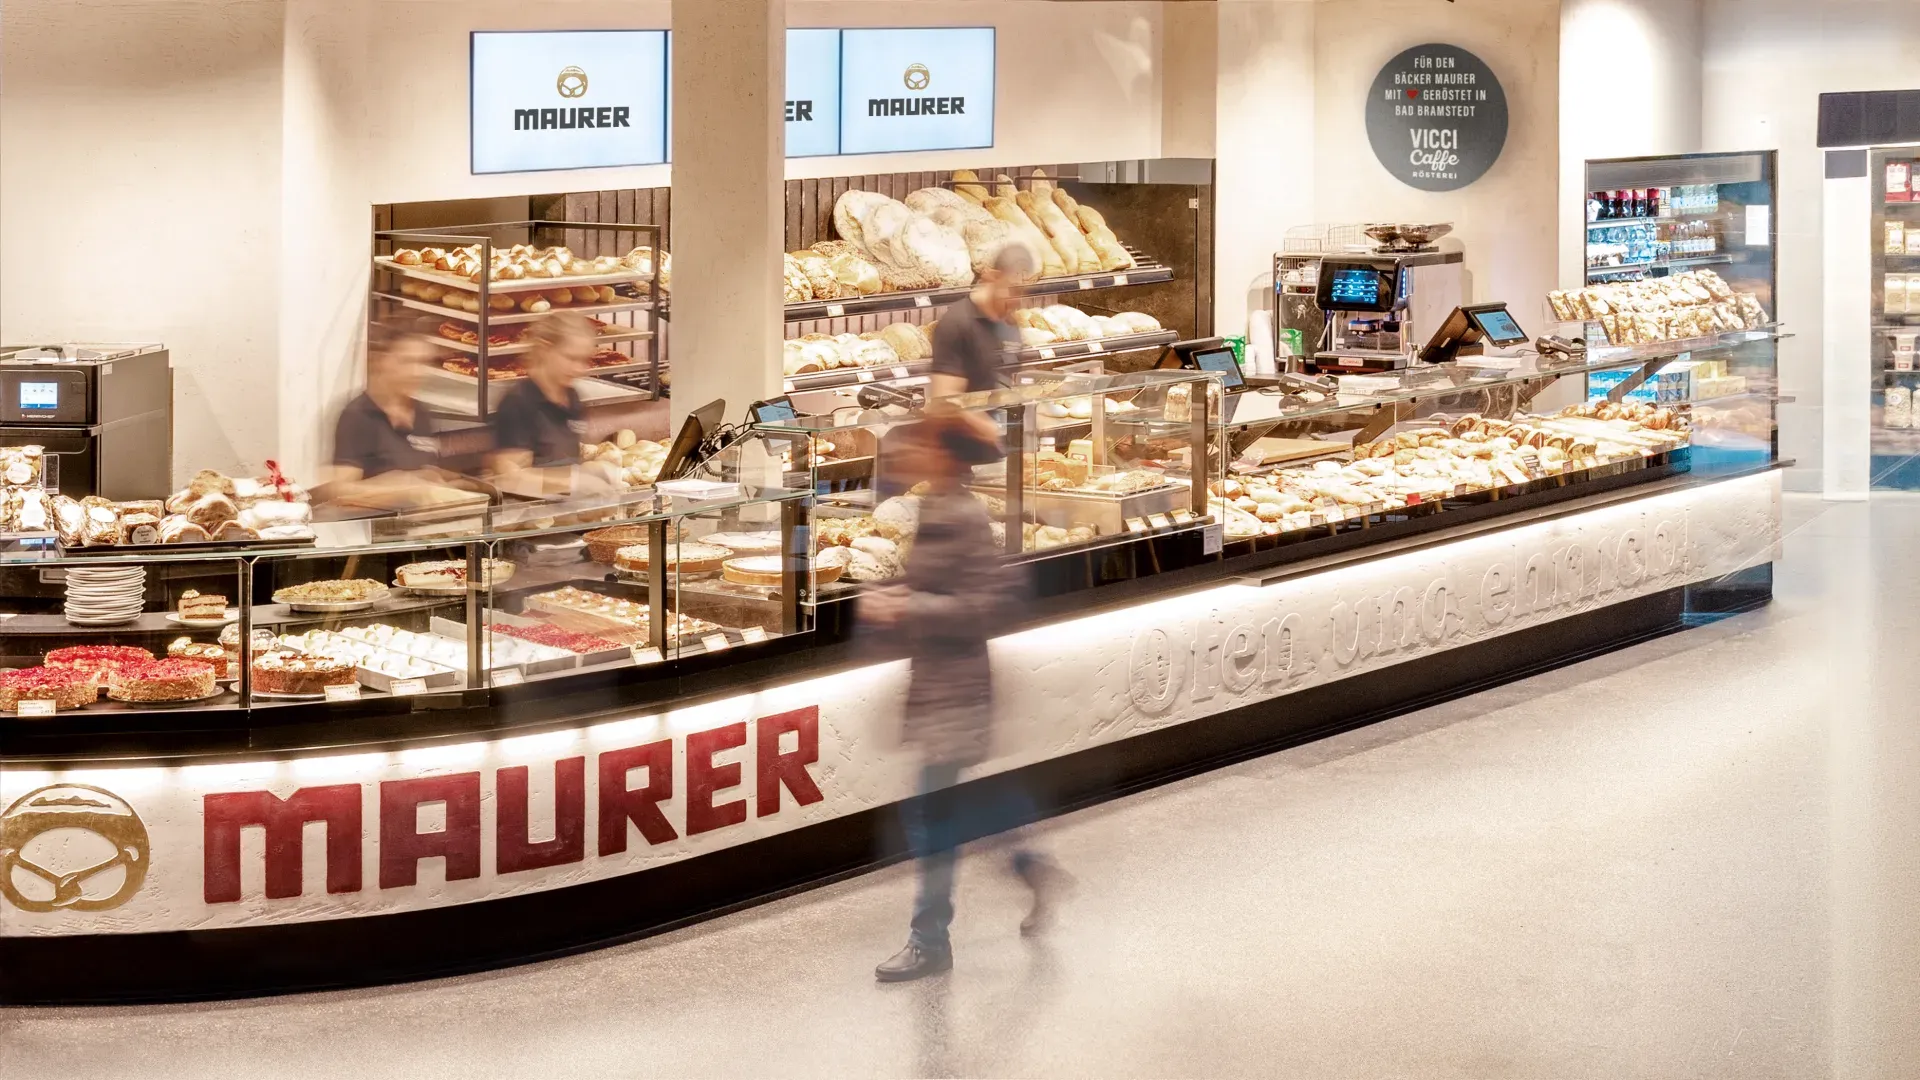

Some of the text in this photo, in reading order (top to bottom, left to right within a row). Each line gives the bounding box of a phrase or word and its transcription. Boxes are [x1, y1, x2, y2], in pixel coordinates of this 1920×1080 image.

[1414, 55, 1455, 69] FÜR DEN
[1394, 71, 1476, 85] BÄCKER MAURER
[1384, 87, 1487, 101] MIT GERÖSTET IN
[785, 100, 813, 121] ER
[868, 96, 965, 117] MAURER
[1395, 105, 1475, 117] BAD BRAMSTEDT
[514, 106, 630, 131] MAURER
[1409, 128, 1458, 150] VICCI
[1409, 149, 1460, 171] Caffe
[1412, 171, 1458, 180] RÖSTEREI
[203, 705, 825, 904] MAURER
